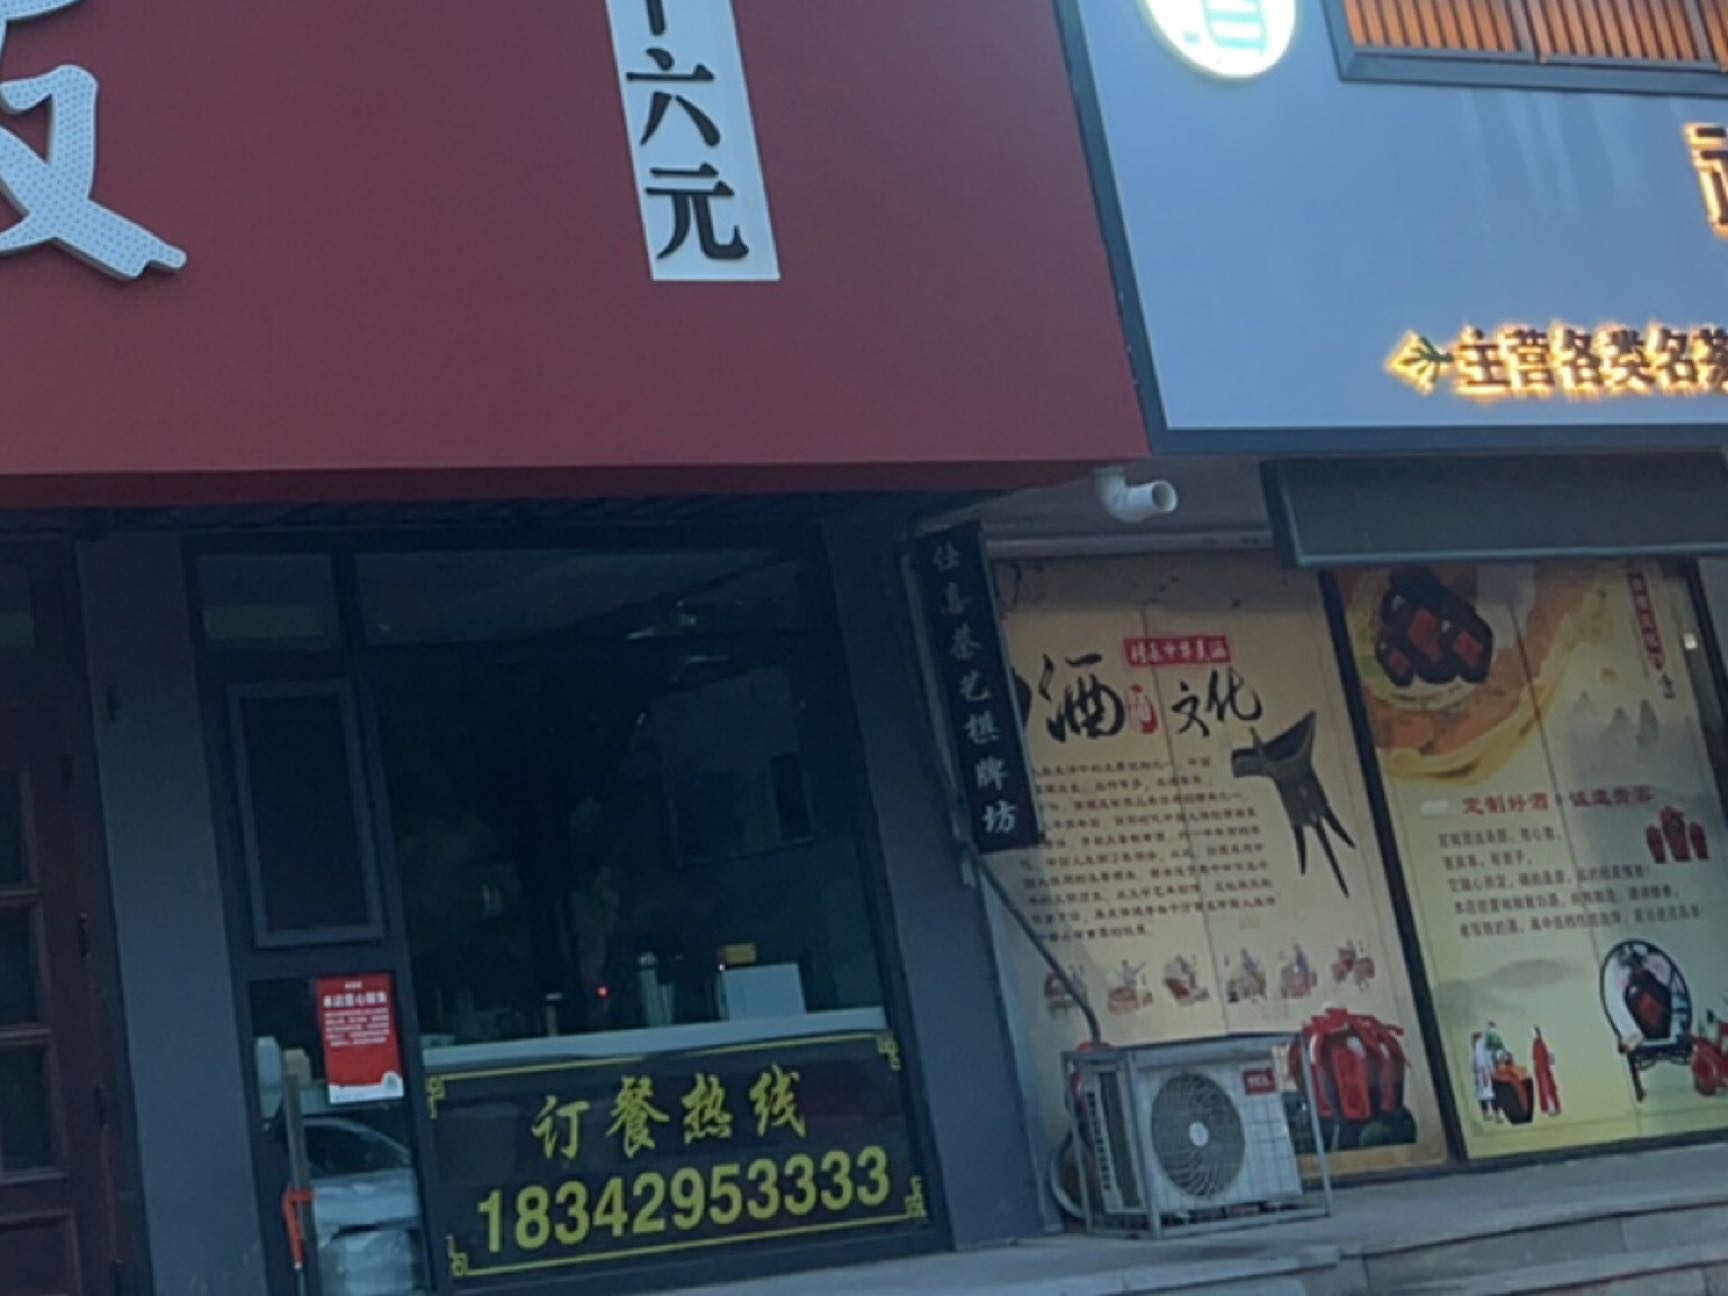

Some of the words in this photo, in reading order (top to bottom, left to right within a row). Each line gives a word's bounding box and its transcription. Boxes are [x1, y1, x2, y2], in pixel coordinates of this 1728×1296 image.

[530, 1063, 809, 1160] 订餐热线
[478, 1144, 893, 1253] 18342953333
